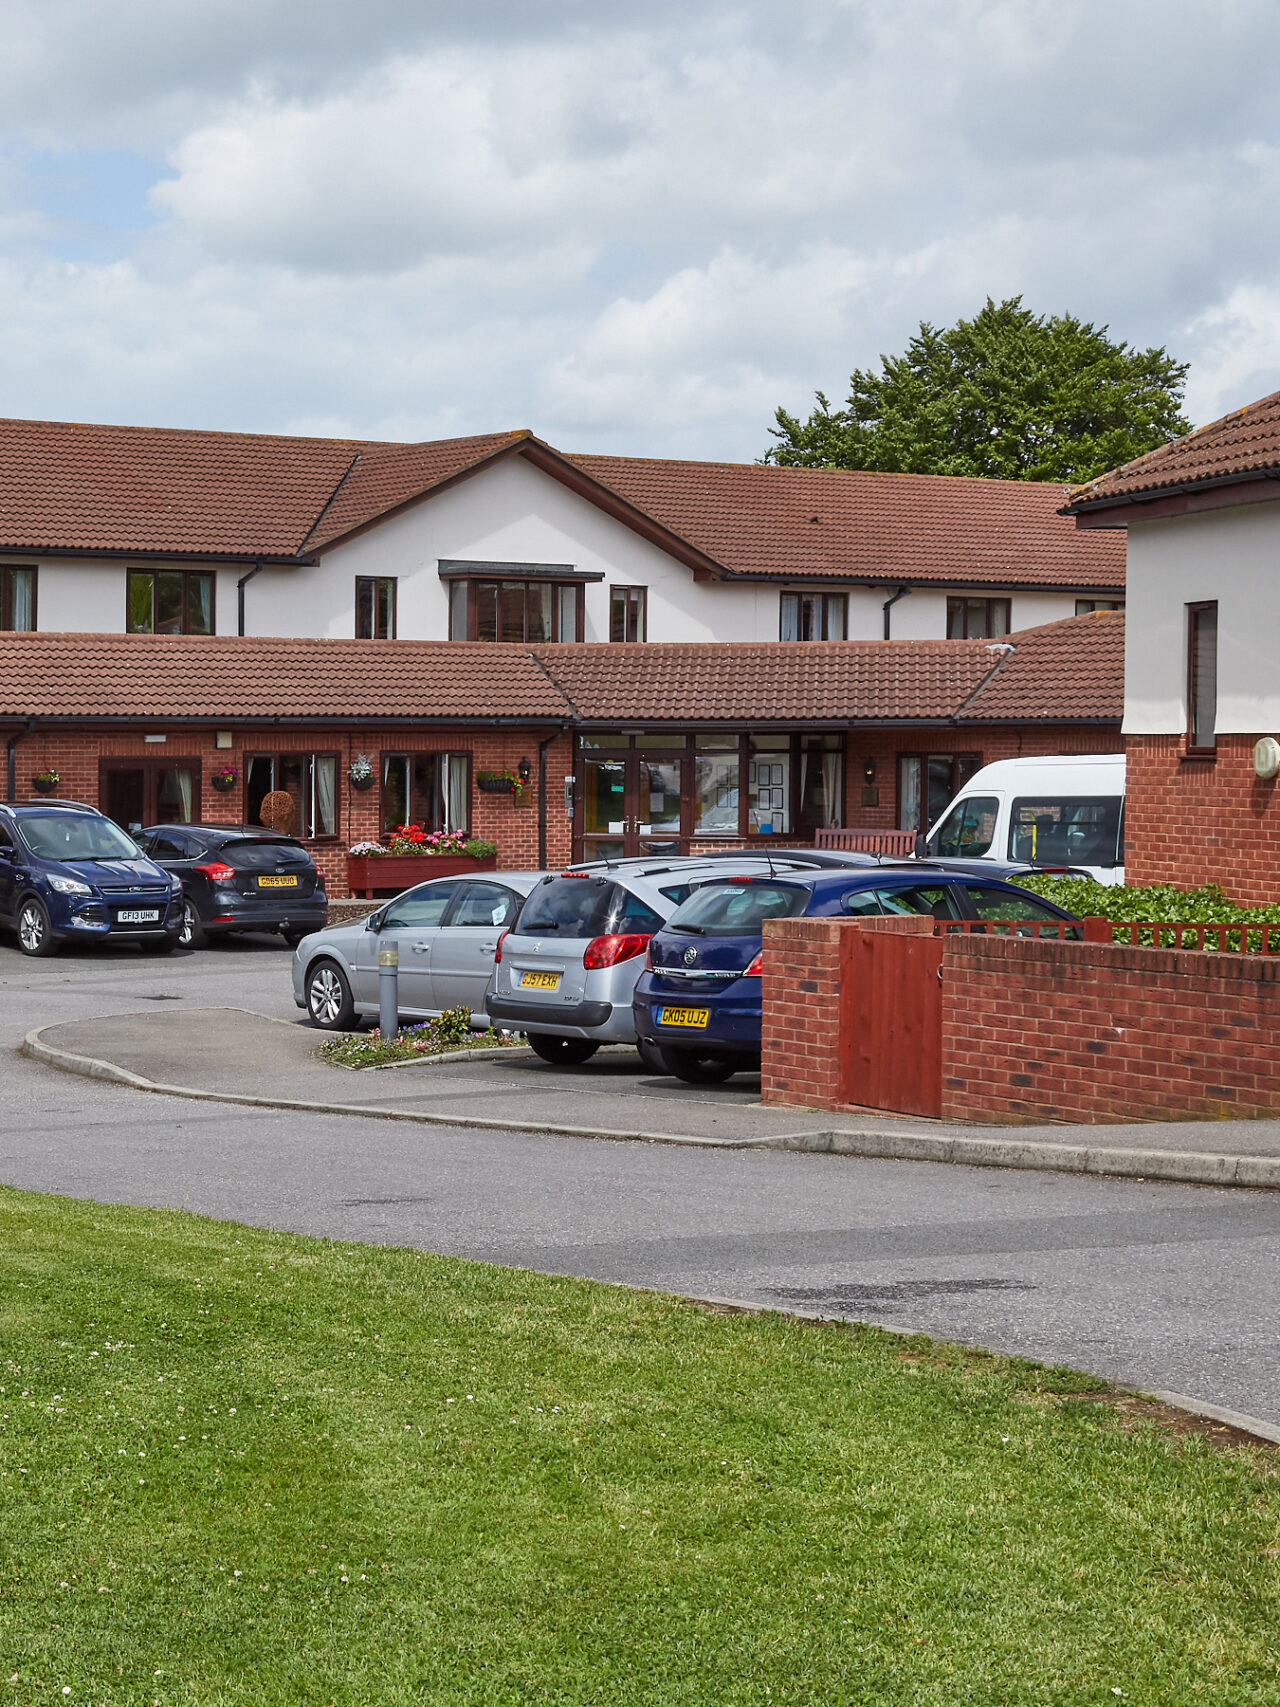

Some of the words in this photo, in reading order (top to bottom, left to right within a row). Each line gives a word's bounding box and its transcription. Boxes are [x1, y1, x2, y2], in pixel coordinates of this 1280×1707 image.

[122, 911, 139, 920] GF13
[140, 911, 155, 919] UHK
[522, 973, 541, 985] GJ57
[541, 974, 558, 987] EXH
[662, 1009, 686, 1023] GK05
[687, 1010, 707, 1024] UJZ
